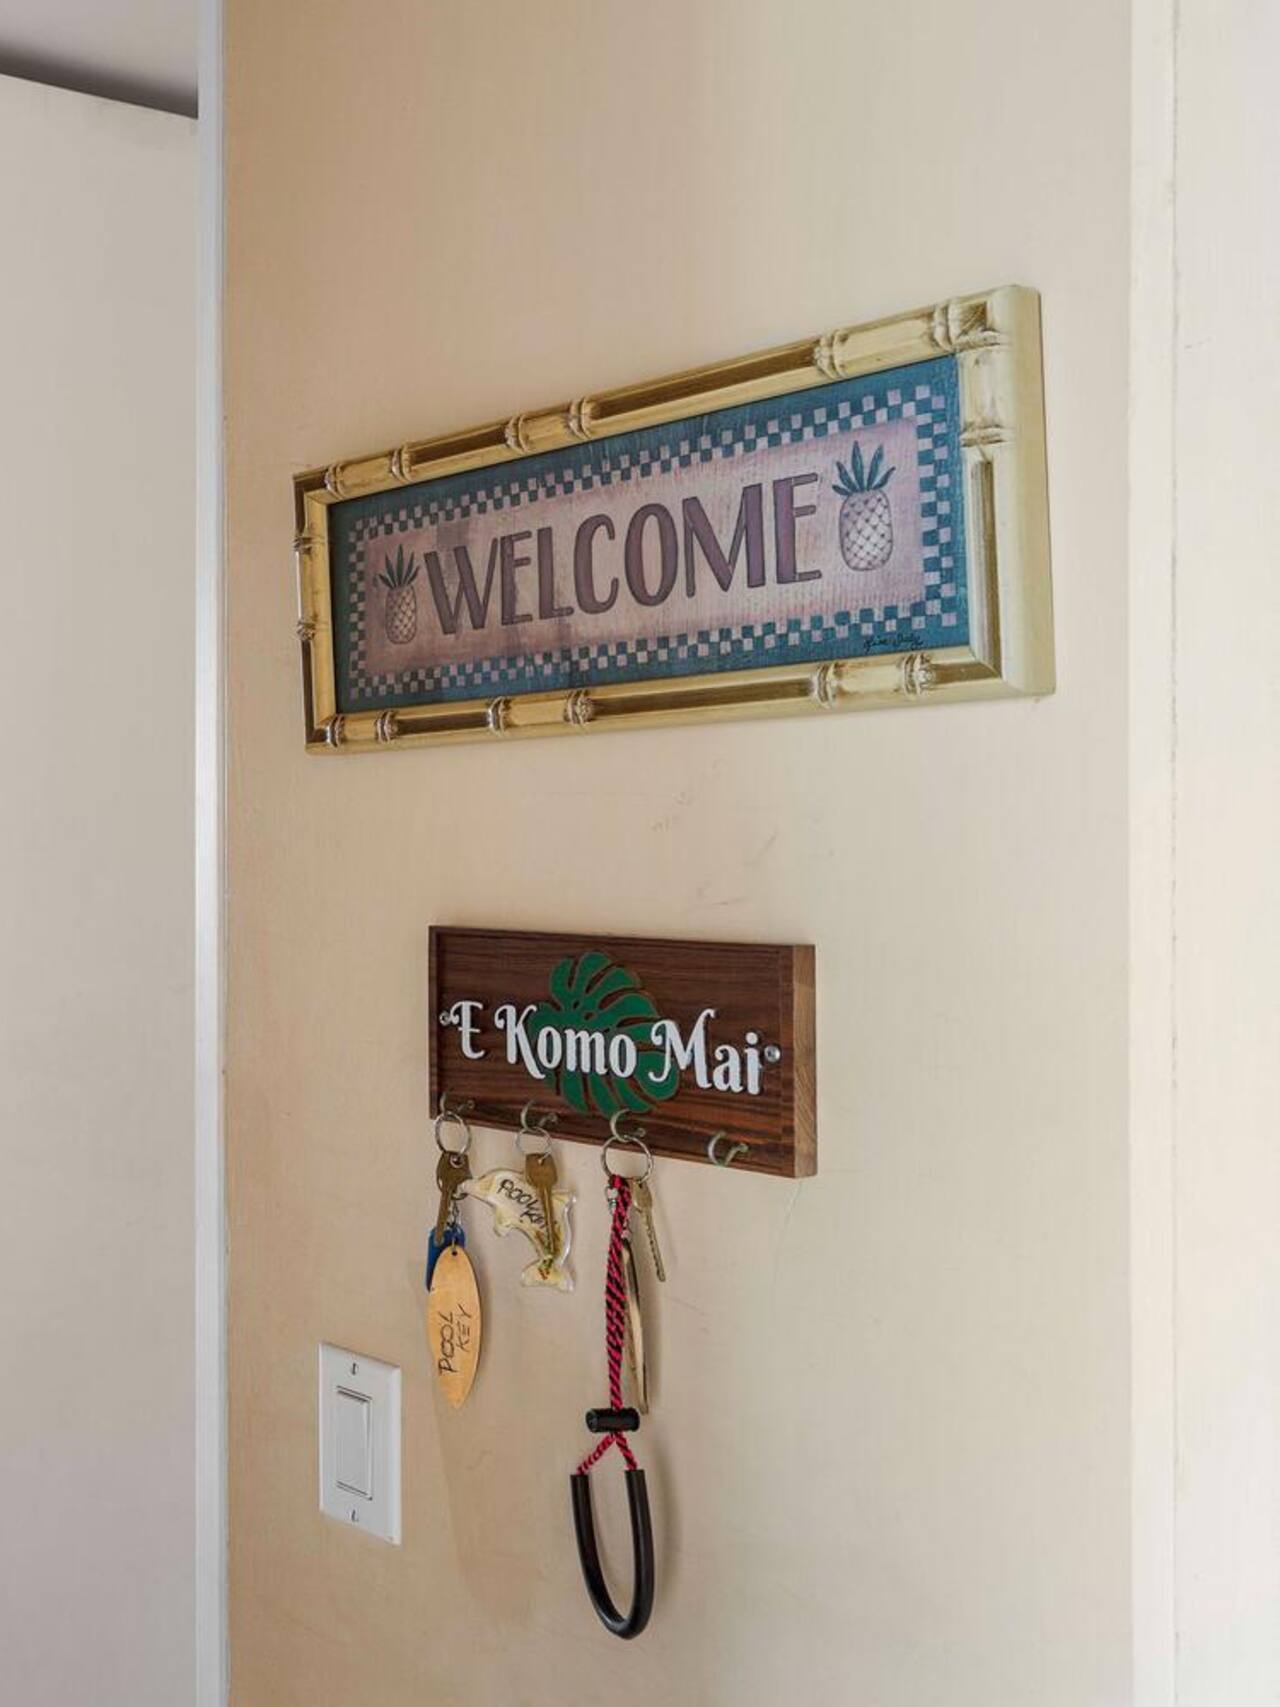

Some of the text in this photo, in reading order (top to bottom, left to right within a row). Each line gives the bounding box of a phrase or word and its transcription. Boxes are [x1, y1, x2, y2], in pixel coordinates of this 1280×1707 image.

[424, 472, 821, 636] WELCOME
[494, 1004, 637, 1080] Komo
[647, 1008, 763, 1095] Mai
[437, 1310, 460, 1376] POOL
[455, 1303, 472, 1352] KEY
